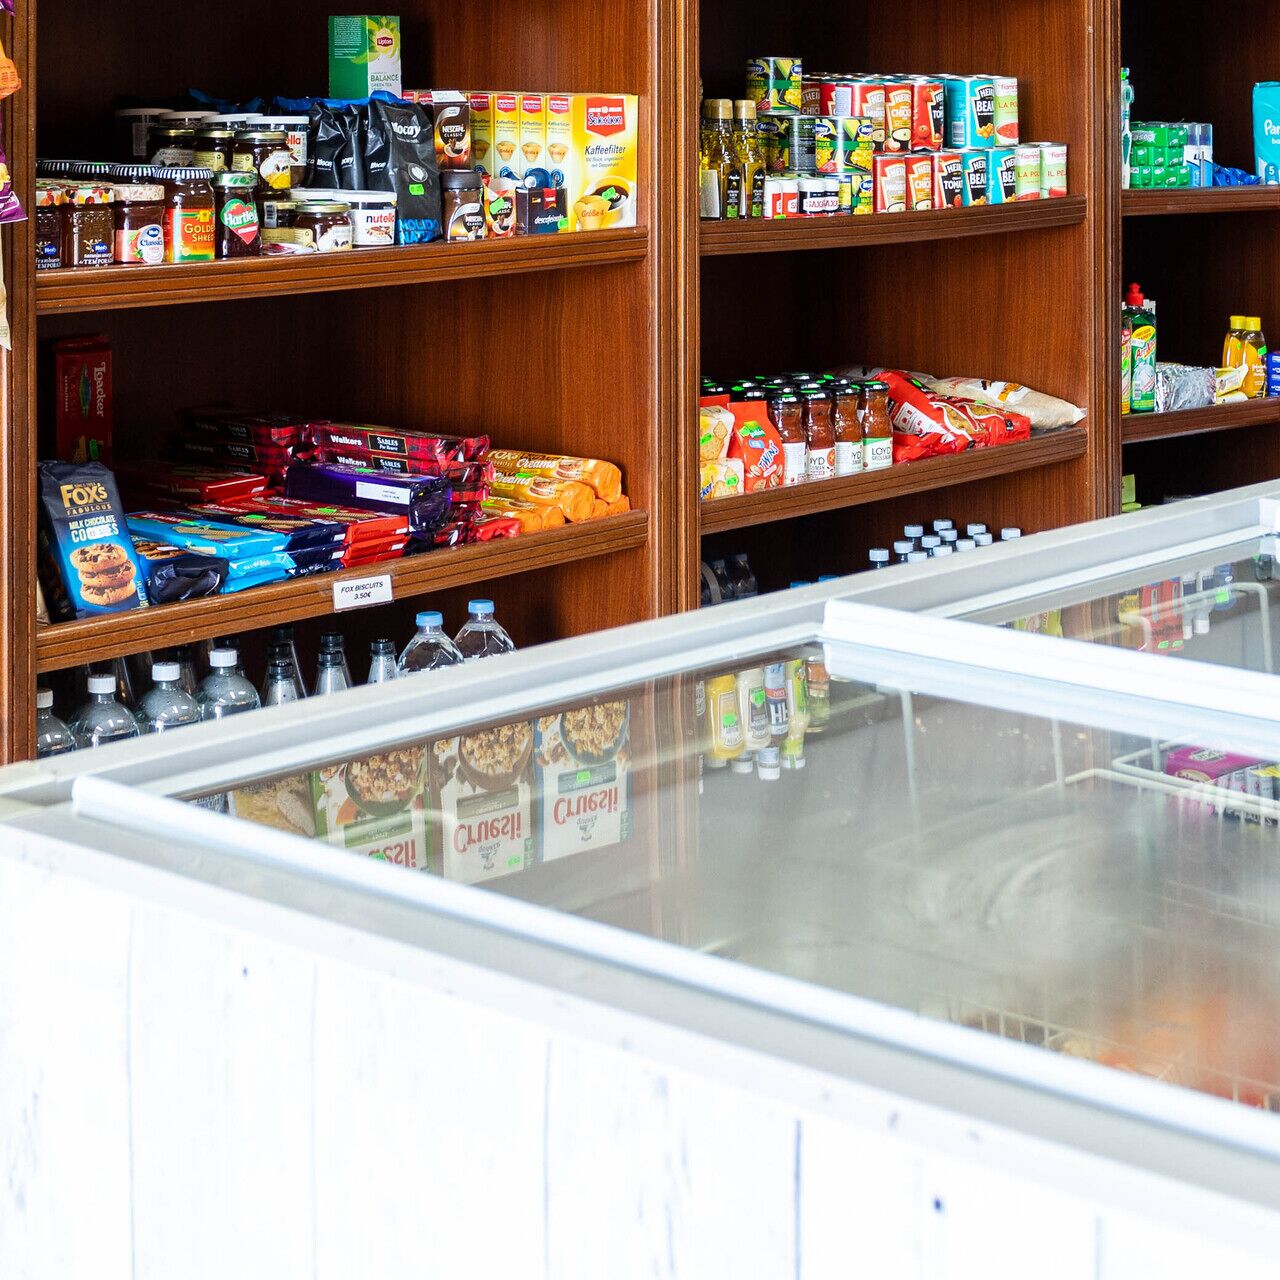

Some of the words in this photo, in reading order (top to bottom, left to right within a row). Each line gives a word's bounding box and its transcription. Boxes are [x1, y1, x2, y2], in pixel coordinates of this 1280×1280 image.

[370, 72, 399, 83] BALANCE
[584, 144, 626, 155] Kaffeefilter
[330, 434, 362, 447] Walkers
[871, 447, 891, 458] LOYD
[337, 453, 366, 467] Walkers
[66, 505, 113, 516] FABULOUS
[86, 514, 115, 528] CHOCOLATE
[340, 583, 354, 594] FOX
[355, 581, 384, 593] BISCUITS
[353, 591, 372, 601] 3.50€
